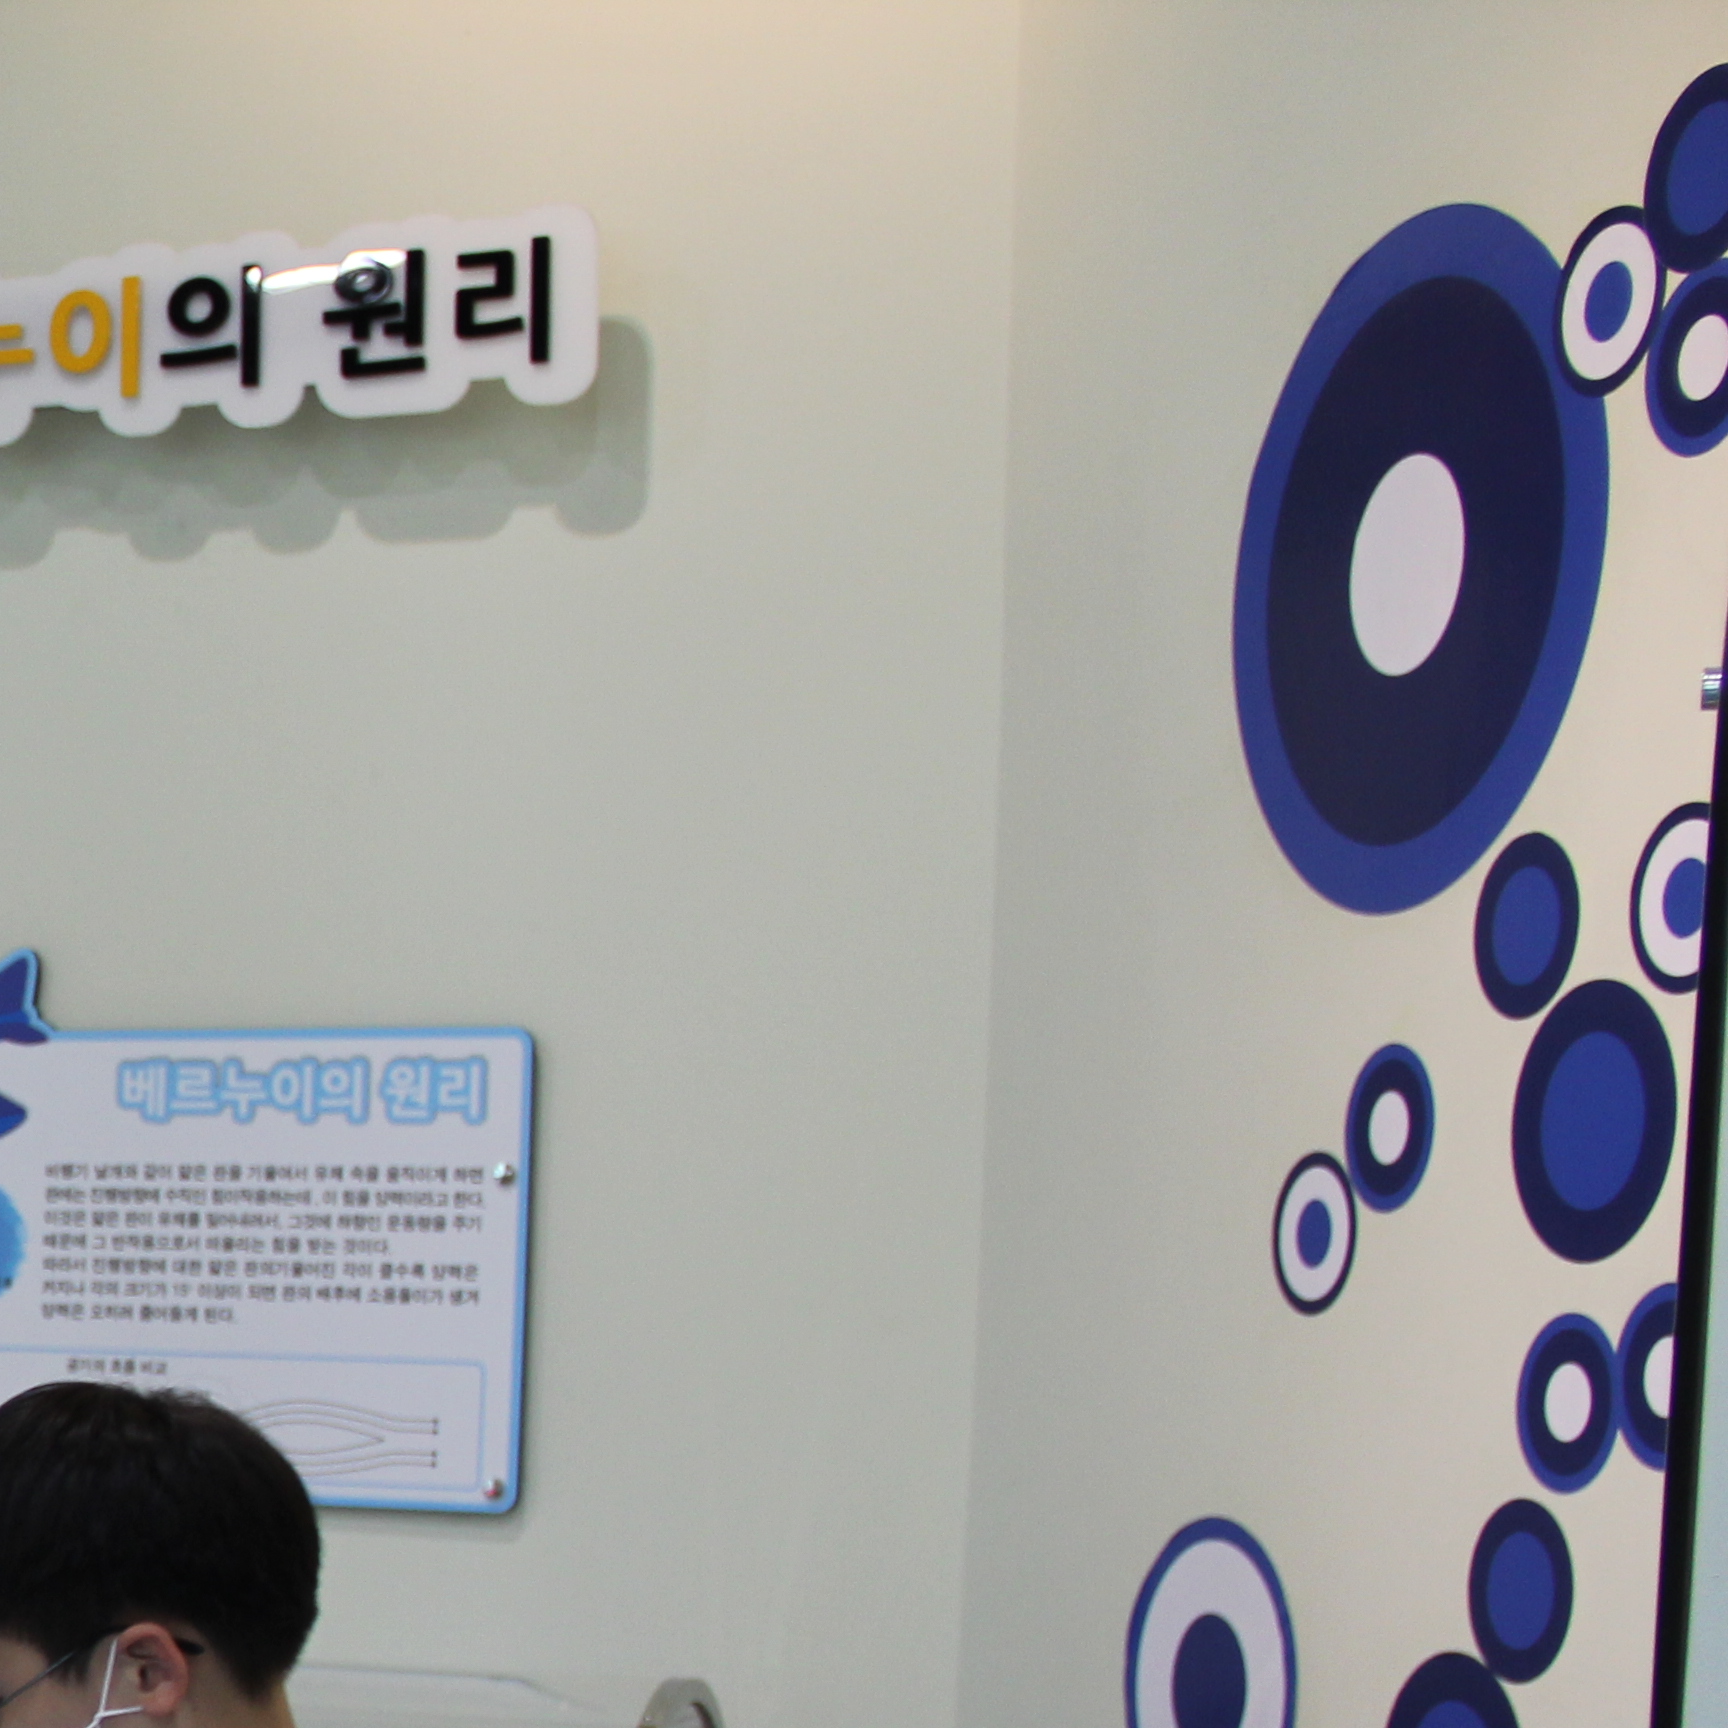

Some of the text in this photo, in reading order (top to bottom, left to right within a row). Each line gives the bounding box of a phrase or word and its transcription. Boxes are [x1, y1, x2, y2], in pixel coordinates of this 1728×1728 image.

[323, 235, 553, 380] 원리
[120, 1057, 487, 1124] 베르누이의 원리
